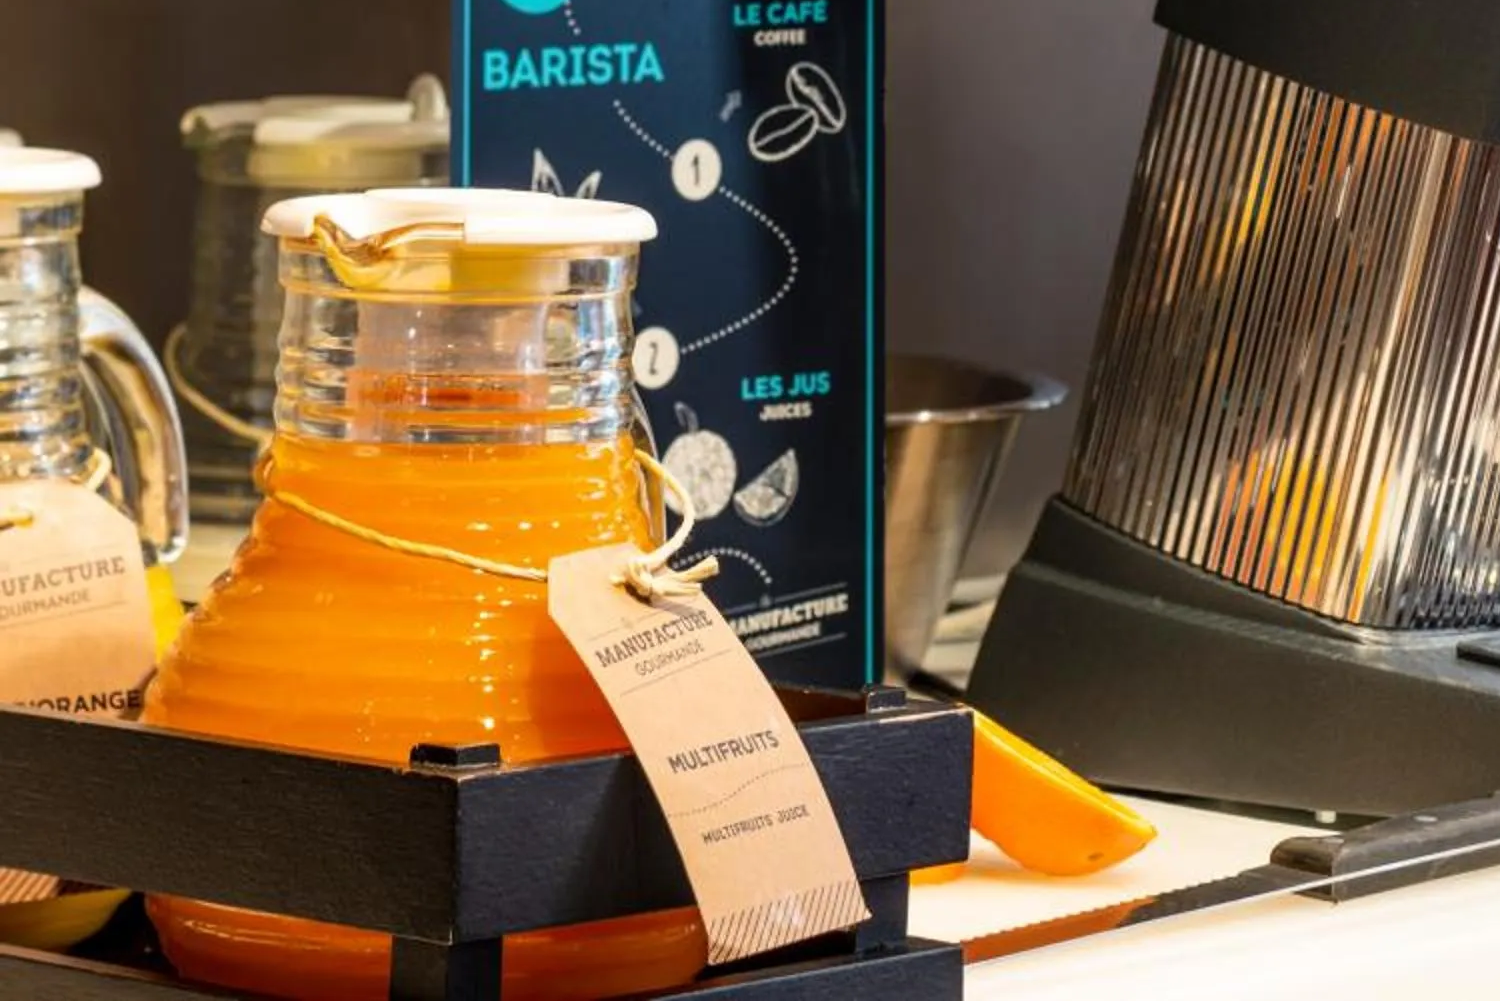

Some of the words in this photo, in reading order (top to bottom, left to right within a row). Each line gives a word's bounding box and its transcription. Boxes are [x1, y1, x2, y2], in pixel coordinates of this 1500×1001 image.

[733, 3, 761, 27] LE
[753, 28, 807, 47] COFFEE
[483, 42, 664, 92] BARISTA
[741, 375, 783, 401] LES
[788, 371, 831, 396] JUS
[759, 400, 813, 421] JUICES
[0, 555, 126, 597] UFACTURE
[595, 608, 714, 668] MANUFACTURE
[634, 638, 706, 677] GOURMANDE
[666, 728, 781, 775] MULTIFRUITS
[702, 814, 774, 845] MULTIFRUITS
[777, 803, 811, 824] JUICE
